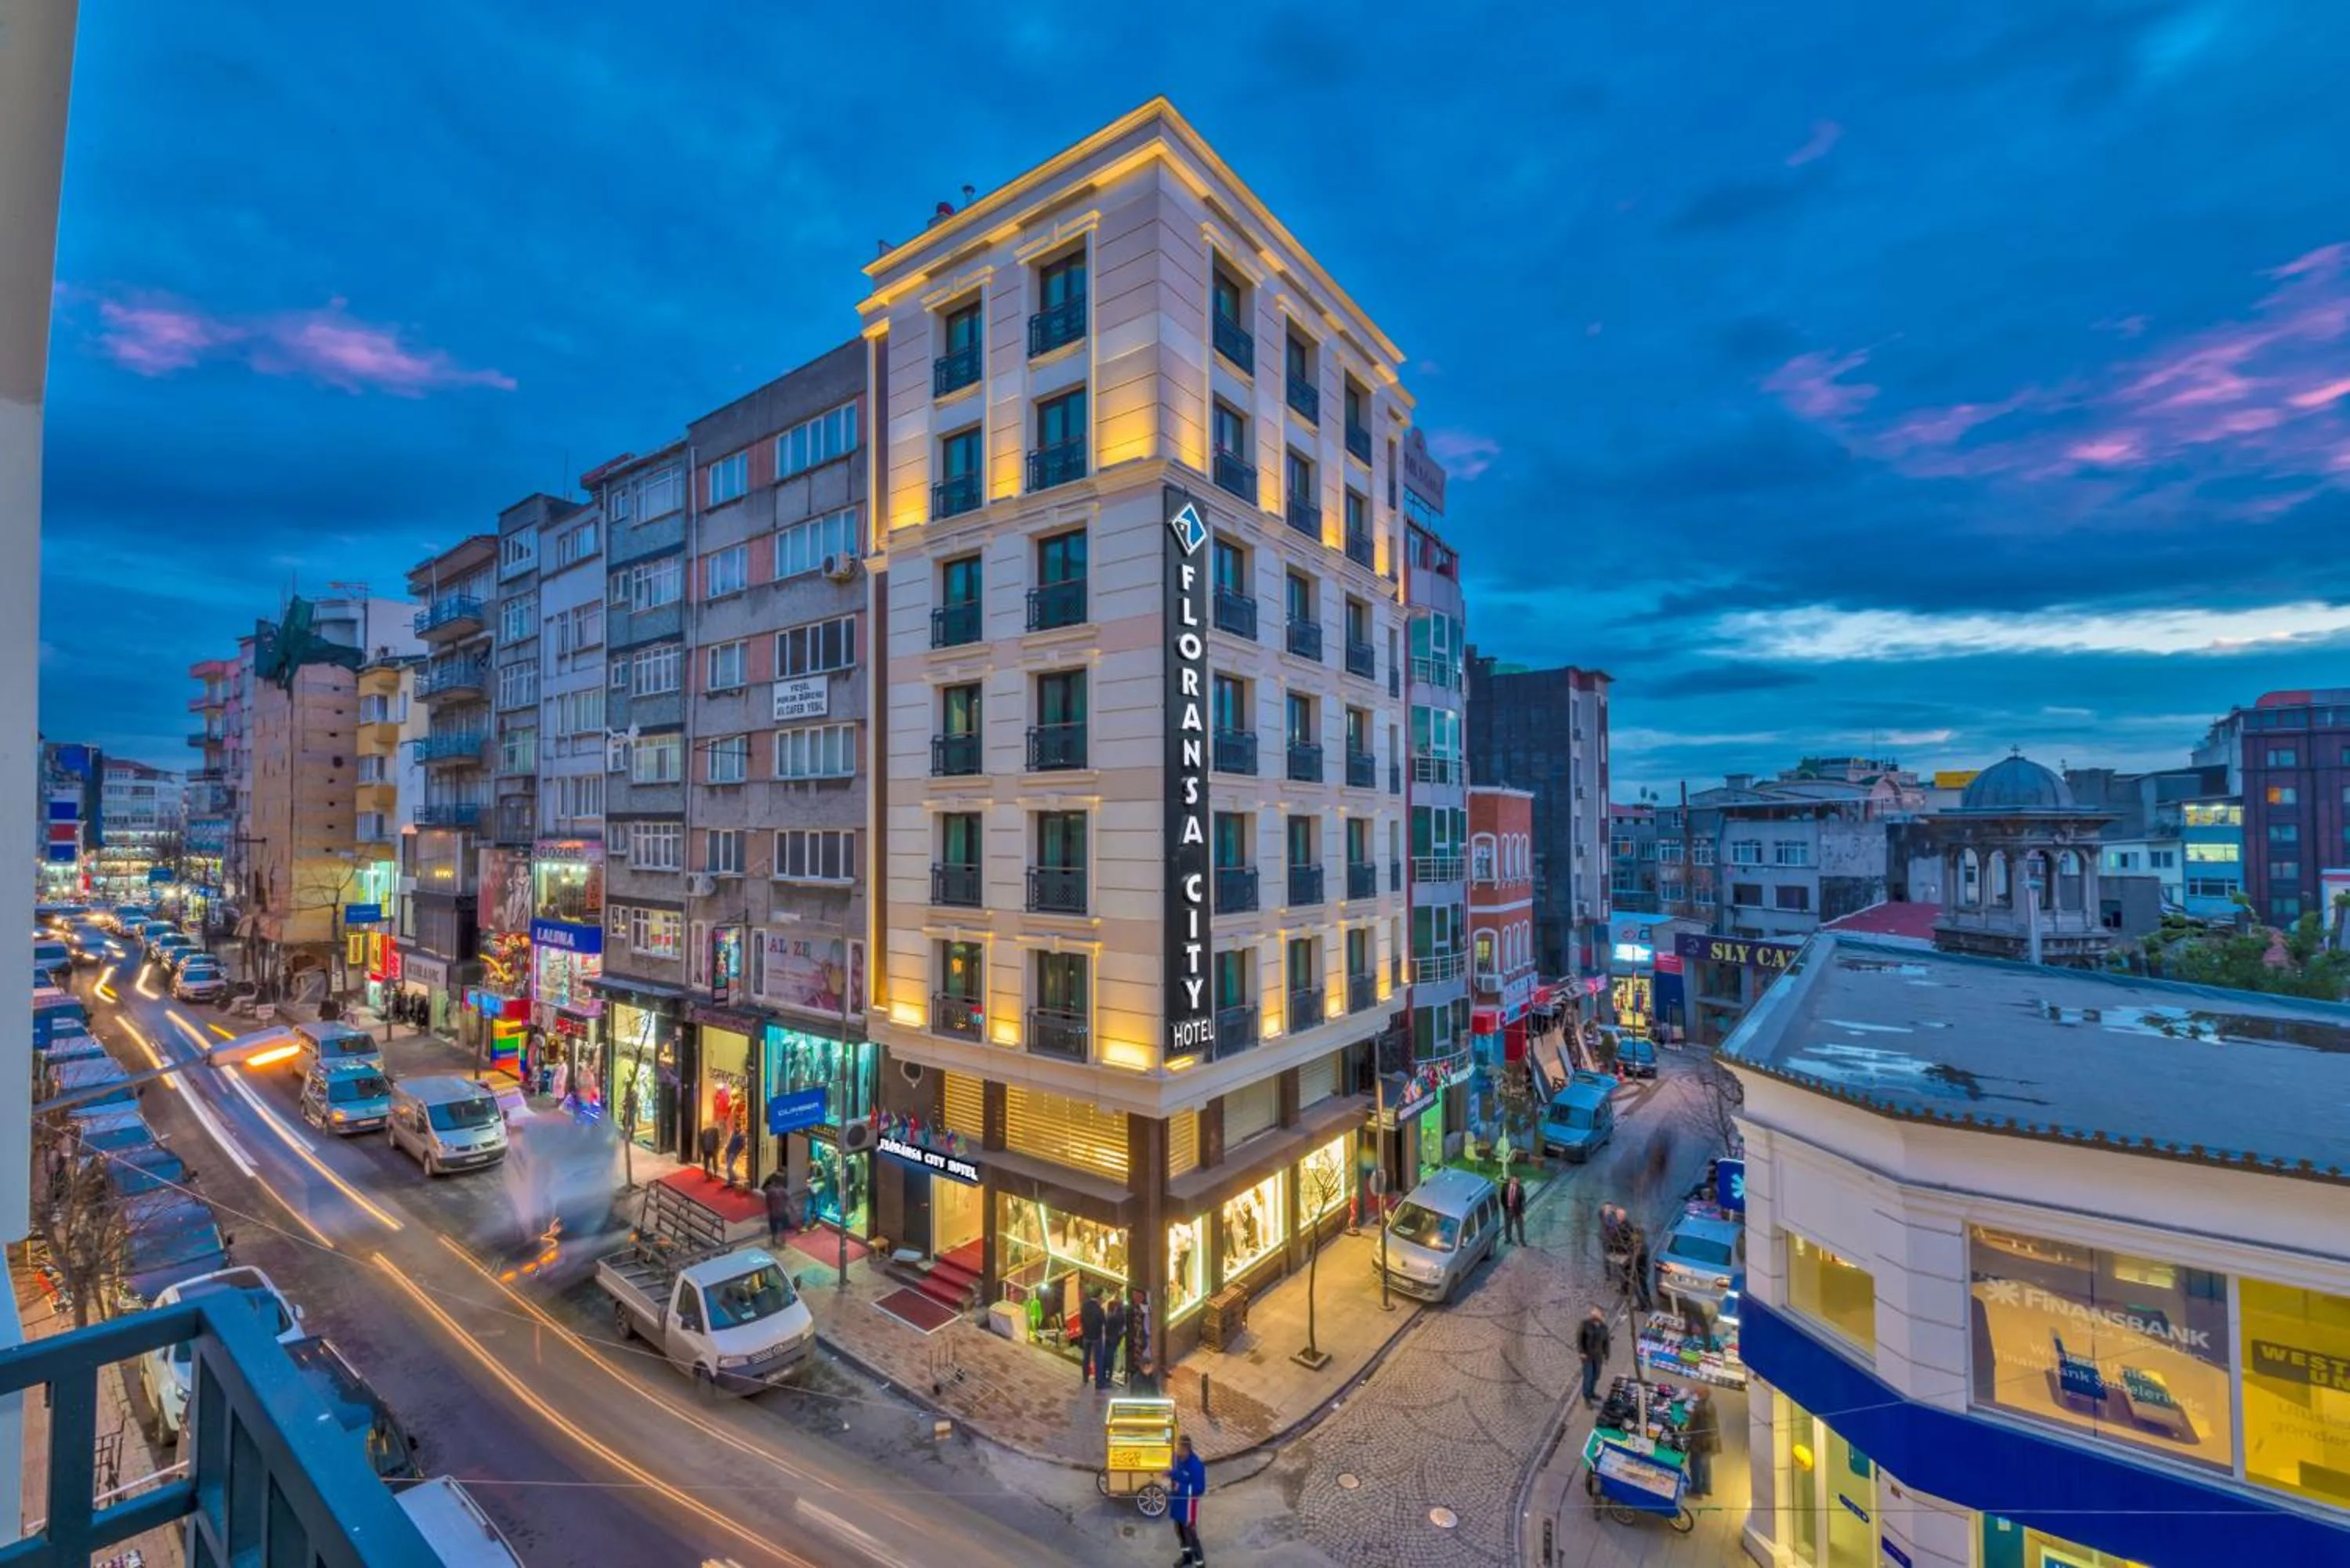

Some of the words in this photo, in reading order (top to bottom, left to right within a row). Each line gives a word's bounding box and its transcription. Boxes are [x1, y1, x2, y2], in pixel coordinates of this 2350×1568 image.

[1179, 564, 1204, 844] FLORANSA
[1185, 873, 1205, 1010] CITY
[1710, 942, 1750, 963] SLY
[1174, 1020, 1214, 1047] HOTEL
[924, 1152, 945, 1168] CITY
